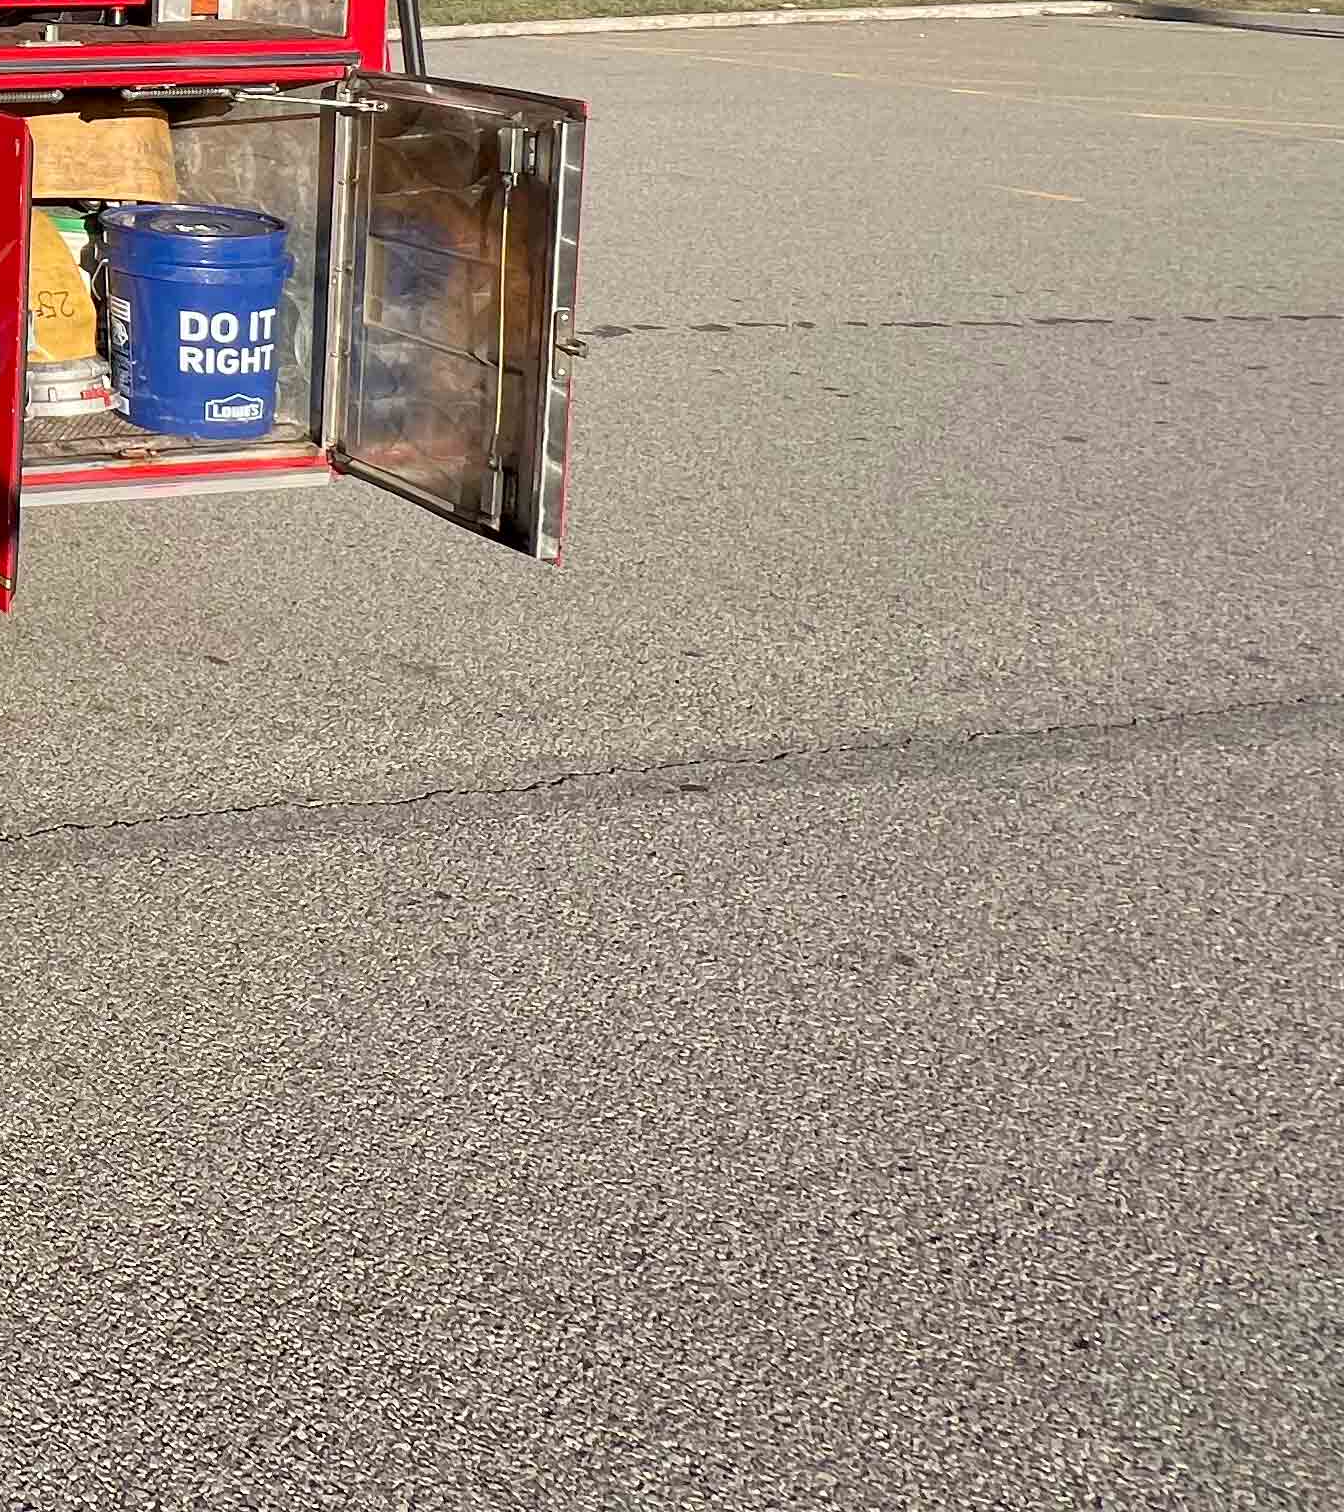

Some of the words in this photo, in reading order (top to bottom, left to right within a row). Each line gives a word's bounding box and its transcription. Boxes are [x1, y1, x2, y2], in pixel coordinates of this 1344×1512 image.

[179, 310, 240, 344] DO
[249, 307, 277, 342] IT
[179, 343, 275, 375] RIGHT
